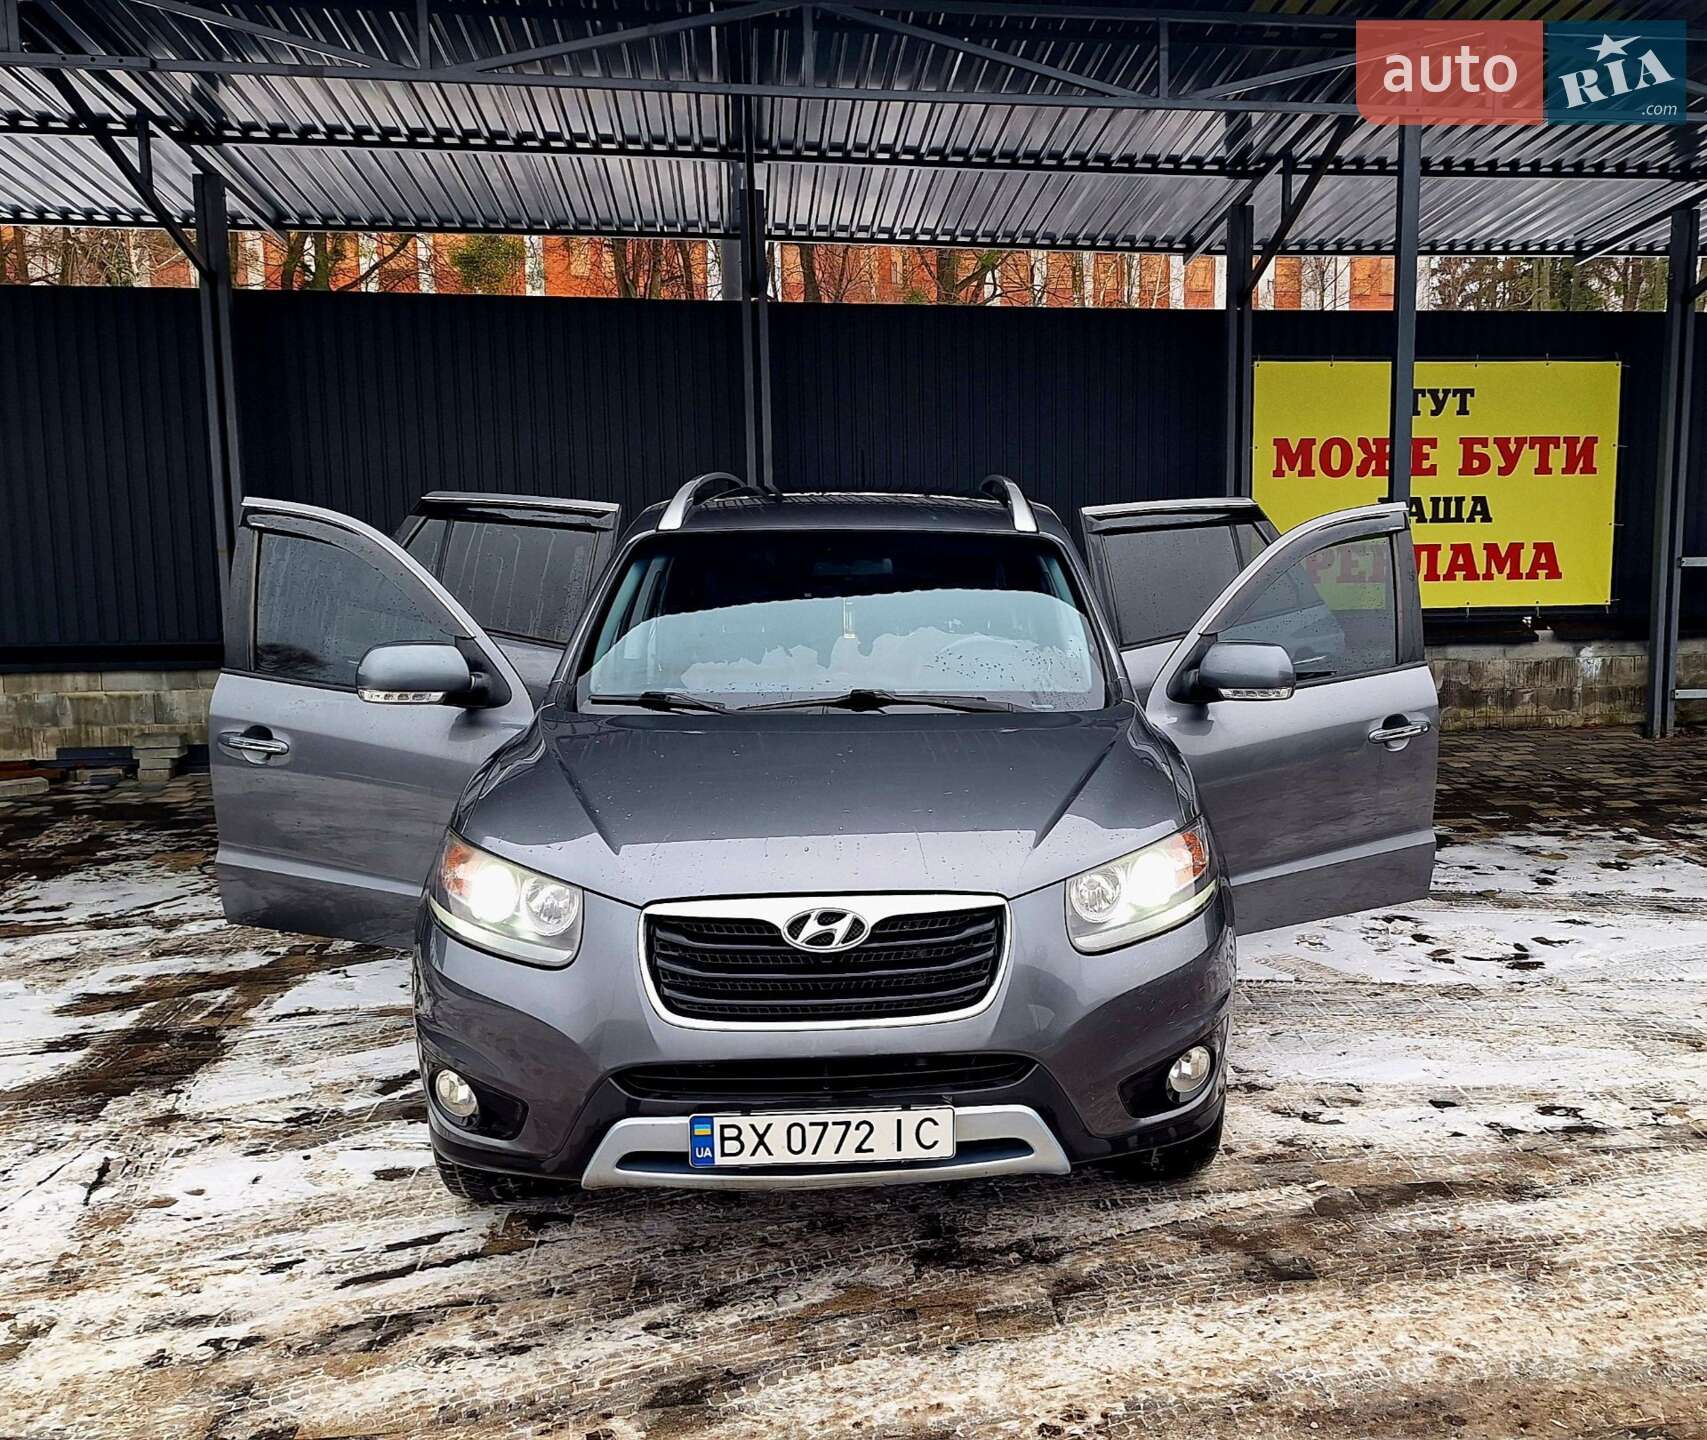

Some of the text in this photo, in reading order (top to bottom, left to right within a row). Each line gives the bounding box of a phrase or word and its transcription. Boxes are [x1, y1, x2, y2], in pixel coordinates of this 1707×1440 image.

[1458, 436, 1598, 477] БУТИ
[1377, 495, 1493, 524] АША
[695, 1147, 713, 1159] UA
[719, 1117, 940, 1158] BX 0772 IC
